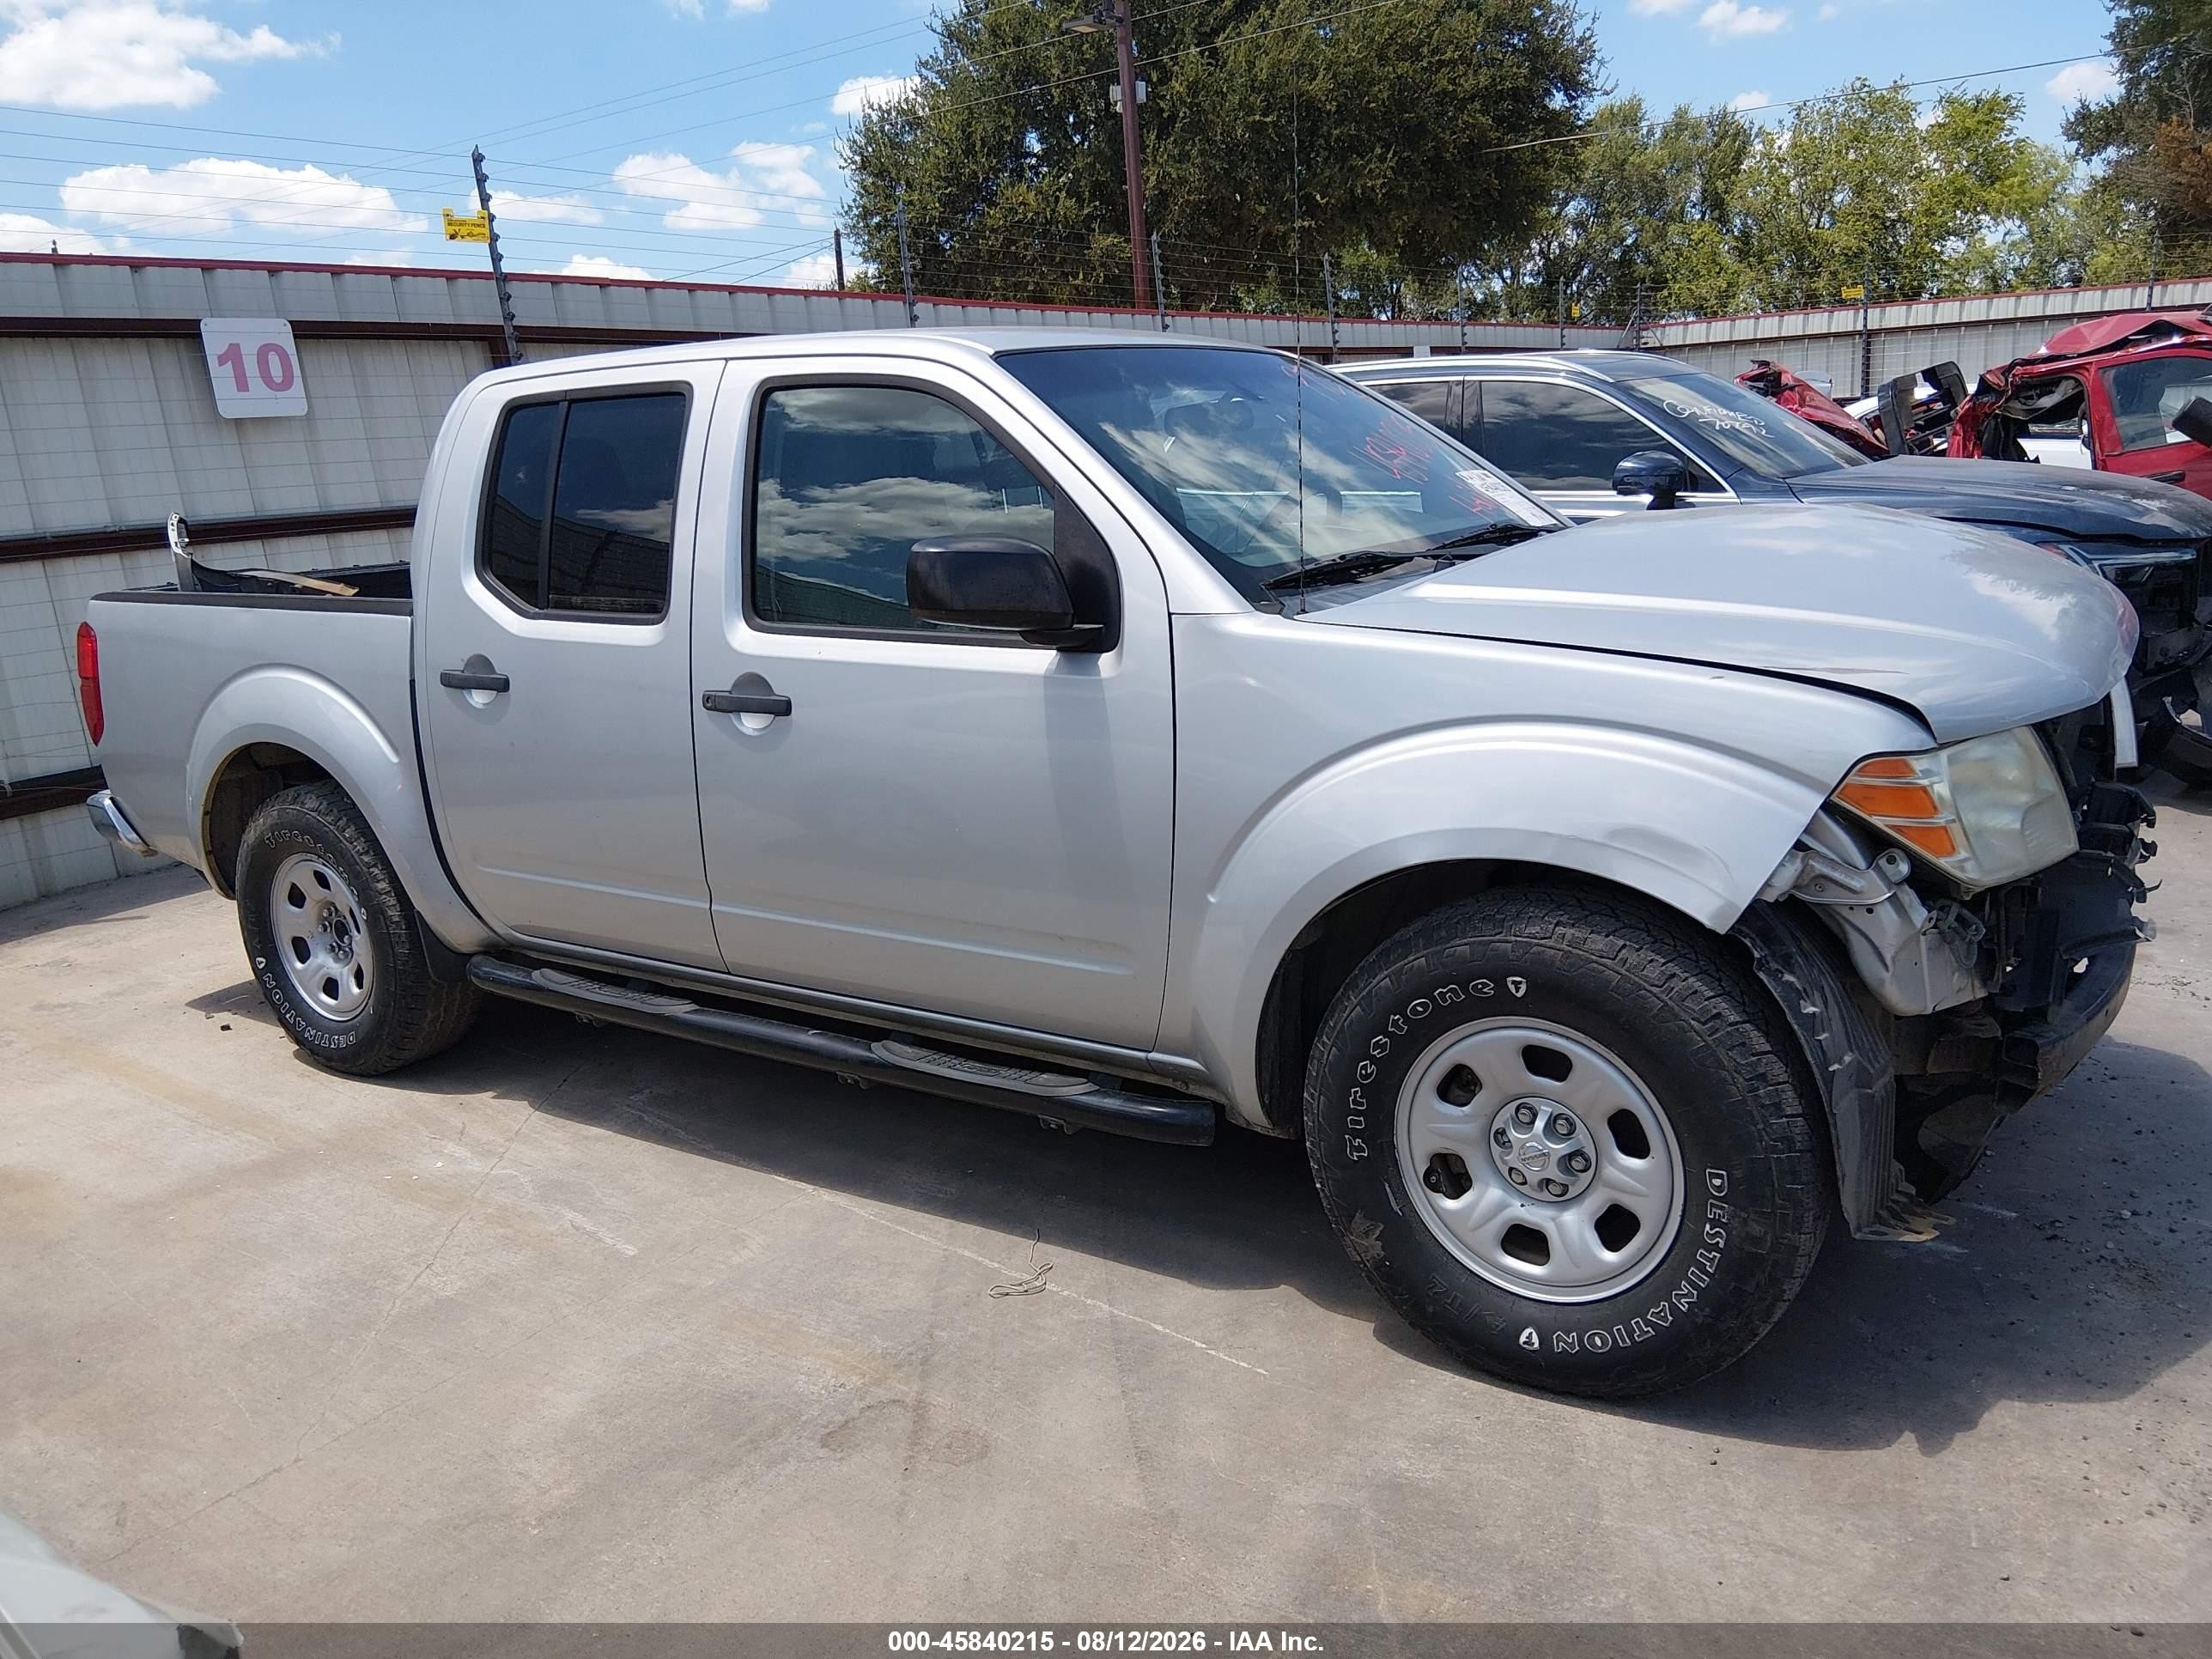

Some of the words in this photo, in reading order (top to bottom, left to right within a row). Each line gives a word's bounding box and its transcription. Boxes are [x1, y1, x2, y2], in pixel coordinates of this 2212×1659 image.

[216, 343, 295, 392] 10
[263, 973, 356, 1048] DESTINATION
[1345, 978, 1495, 1160] Firestone
[1553, 1169, 1729, 1353] DESTINATION
